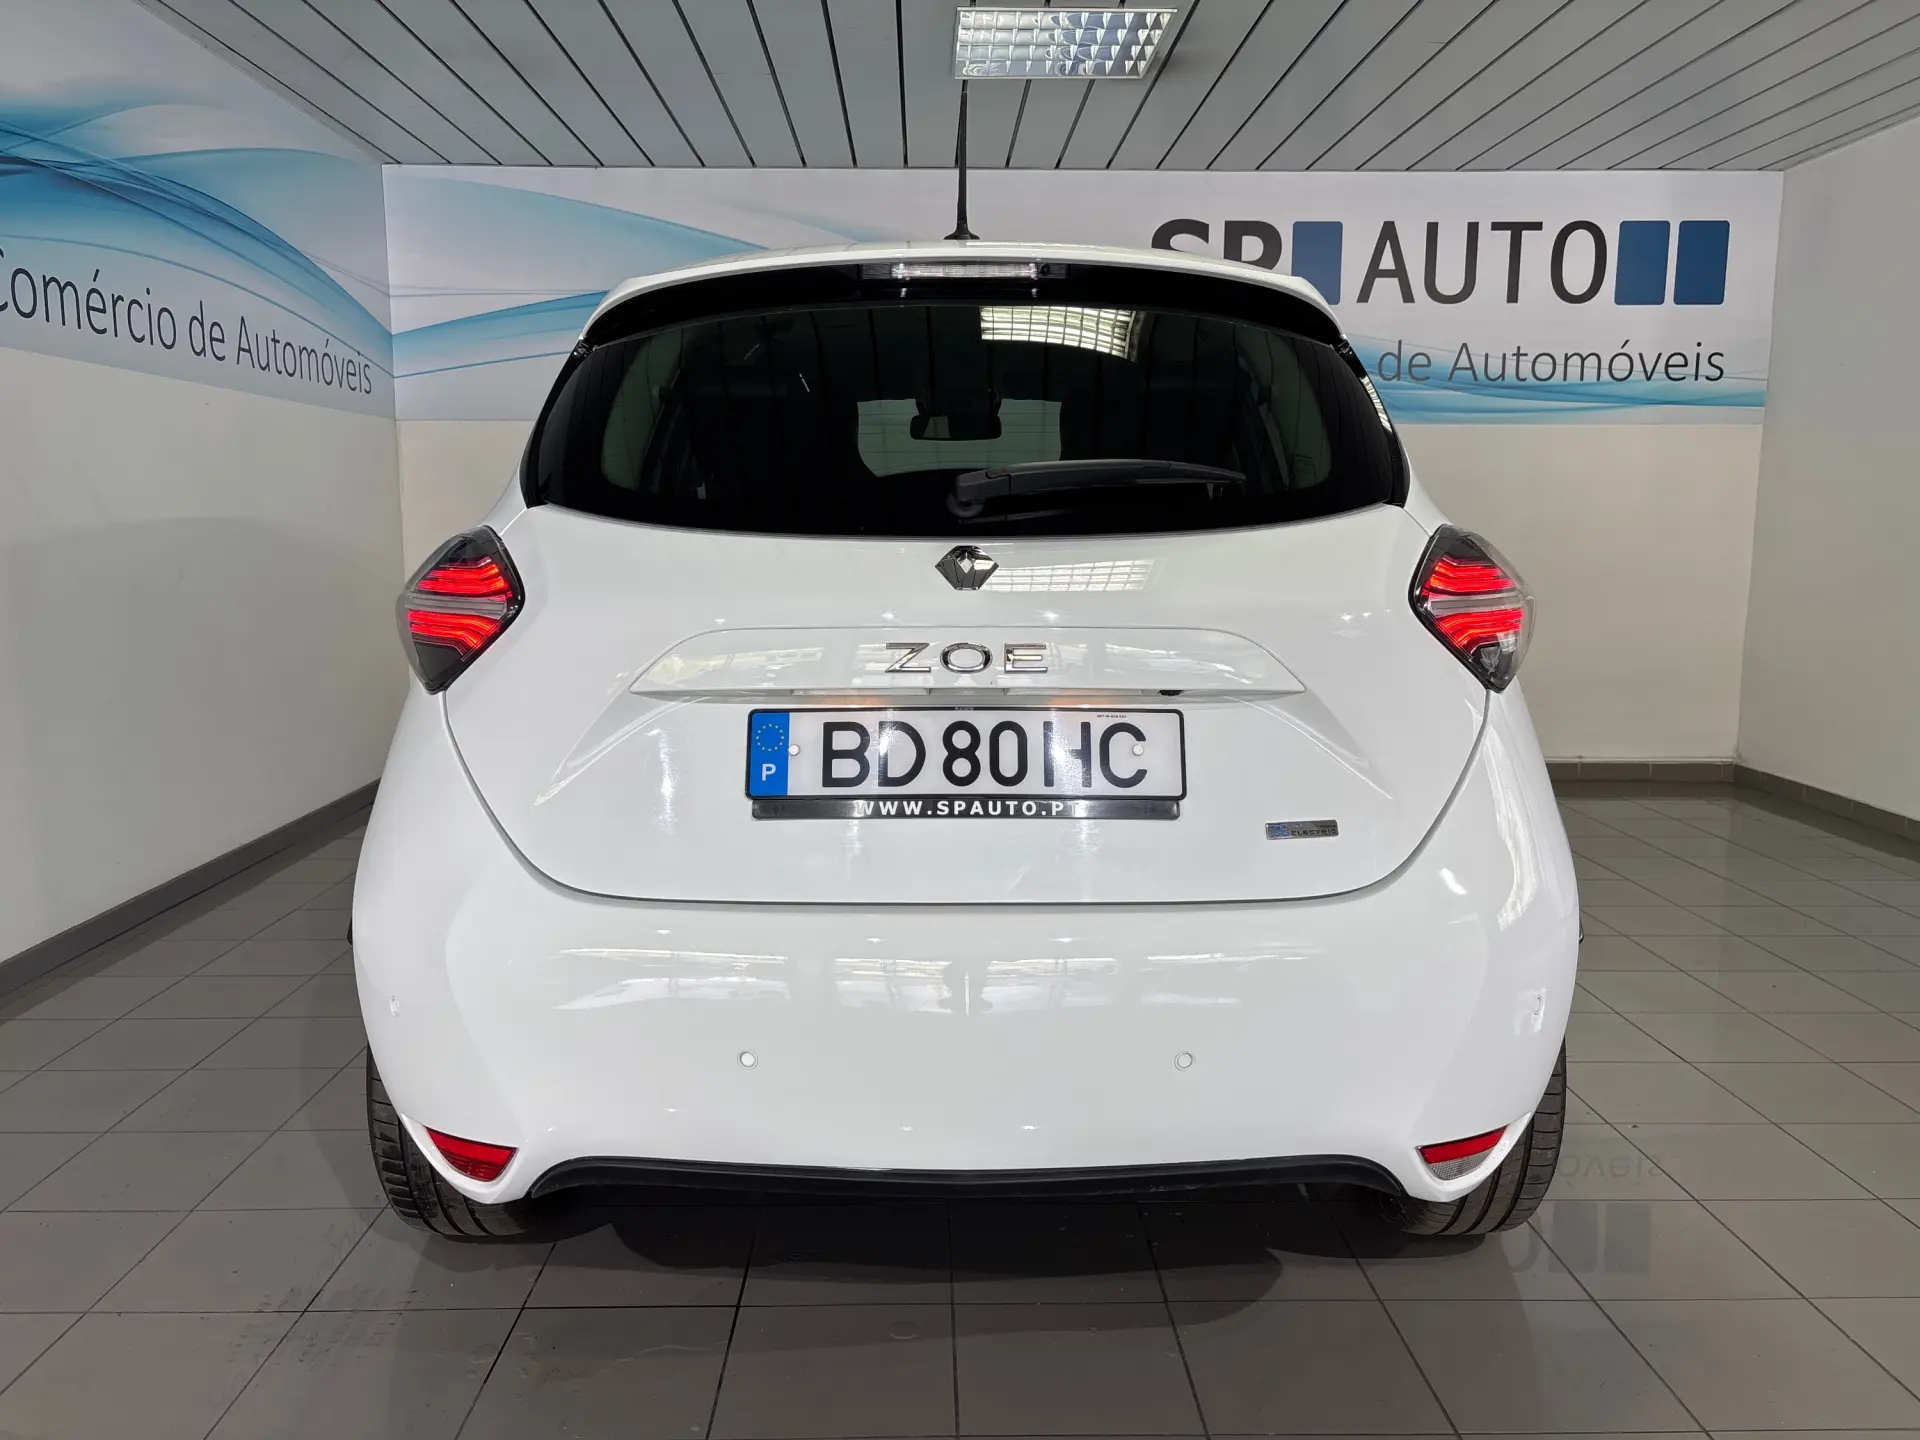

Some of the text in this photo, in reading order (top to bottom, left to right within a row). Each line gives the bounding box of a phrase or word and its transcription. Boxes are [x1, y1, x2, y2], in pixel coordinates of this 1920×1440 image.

[1356, 220, 1608, 305] AUTO
[0, 247, 372, 395] omércio de Automóveis
[1377, 339, 1725, 384] de Automóveis
[885, 642, 1048, 674] ZOE
[761, 763, 777, 782] P
[821, 720, 1148, 788] BD 80 HC
